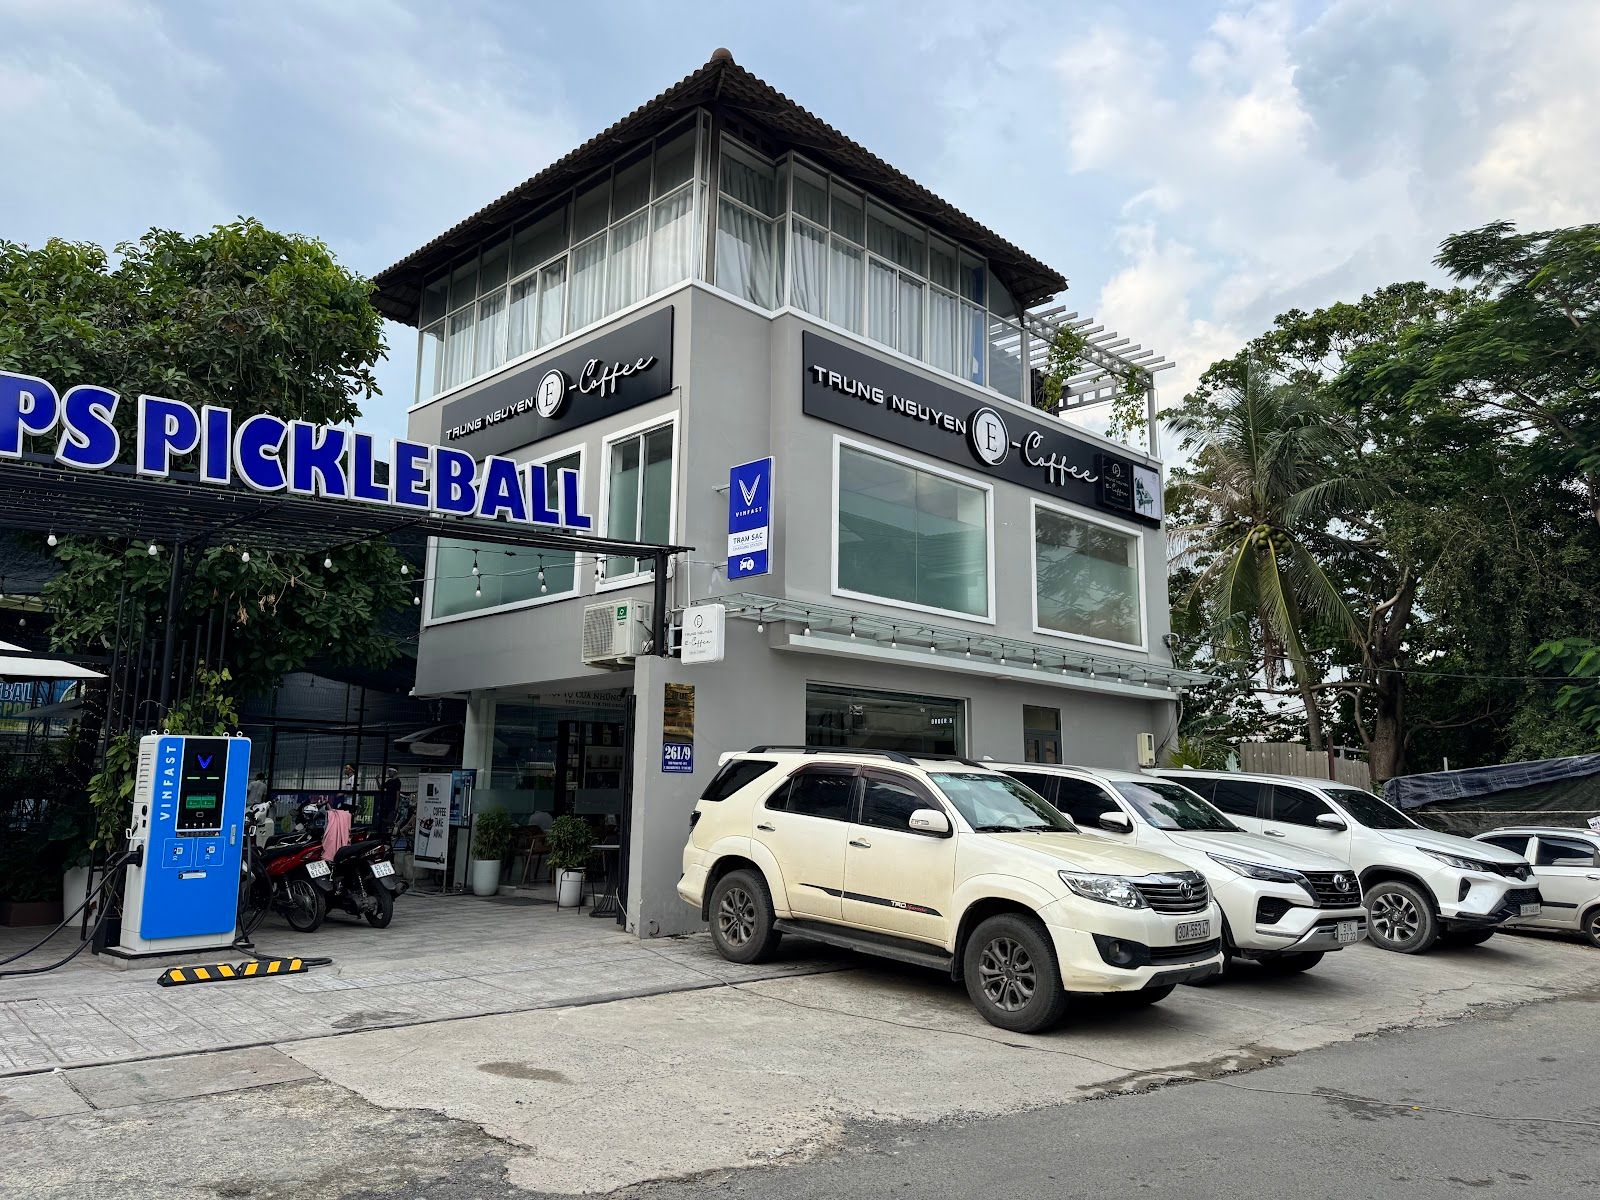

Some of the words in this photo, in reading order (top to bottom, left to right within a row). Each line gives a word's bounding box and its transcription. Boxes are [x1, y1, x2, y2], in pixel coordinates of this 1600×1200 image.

[814, 364, 884, 404] TRUNG
[892, 395, 967, 434] NGUYEN
[445, 417, 482, 441] TRUNG
[485, 396, 534, 425] NGUYEN
[137, 394, 594, 531] PICKLEBALL
[735, 506, 763, 518] VINFAST
[664, 745, 691, 761] 261/9
[160, 745, 177, 821] VINFAST
[432, 806, 447, 817] COFFEE
[890, 900, 907, 909] TRD
